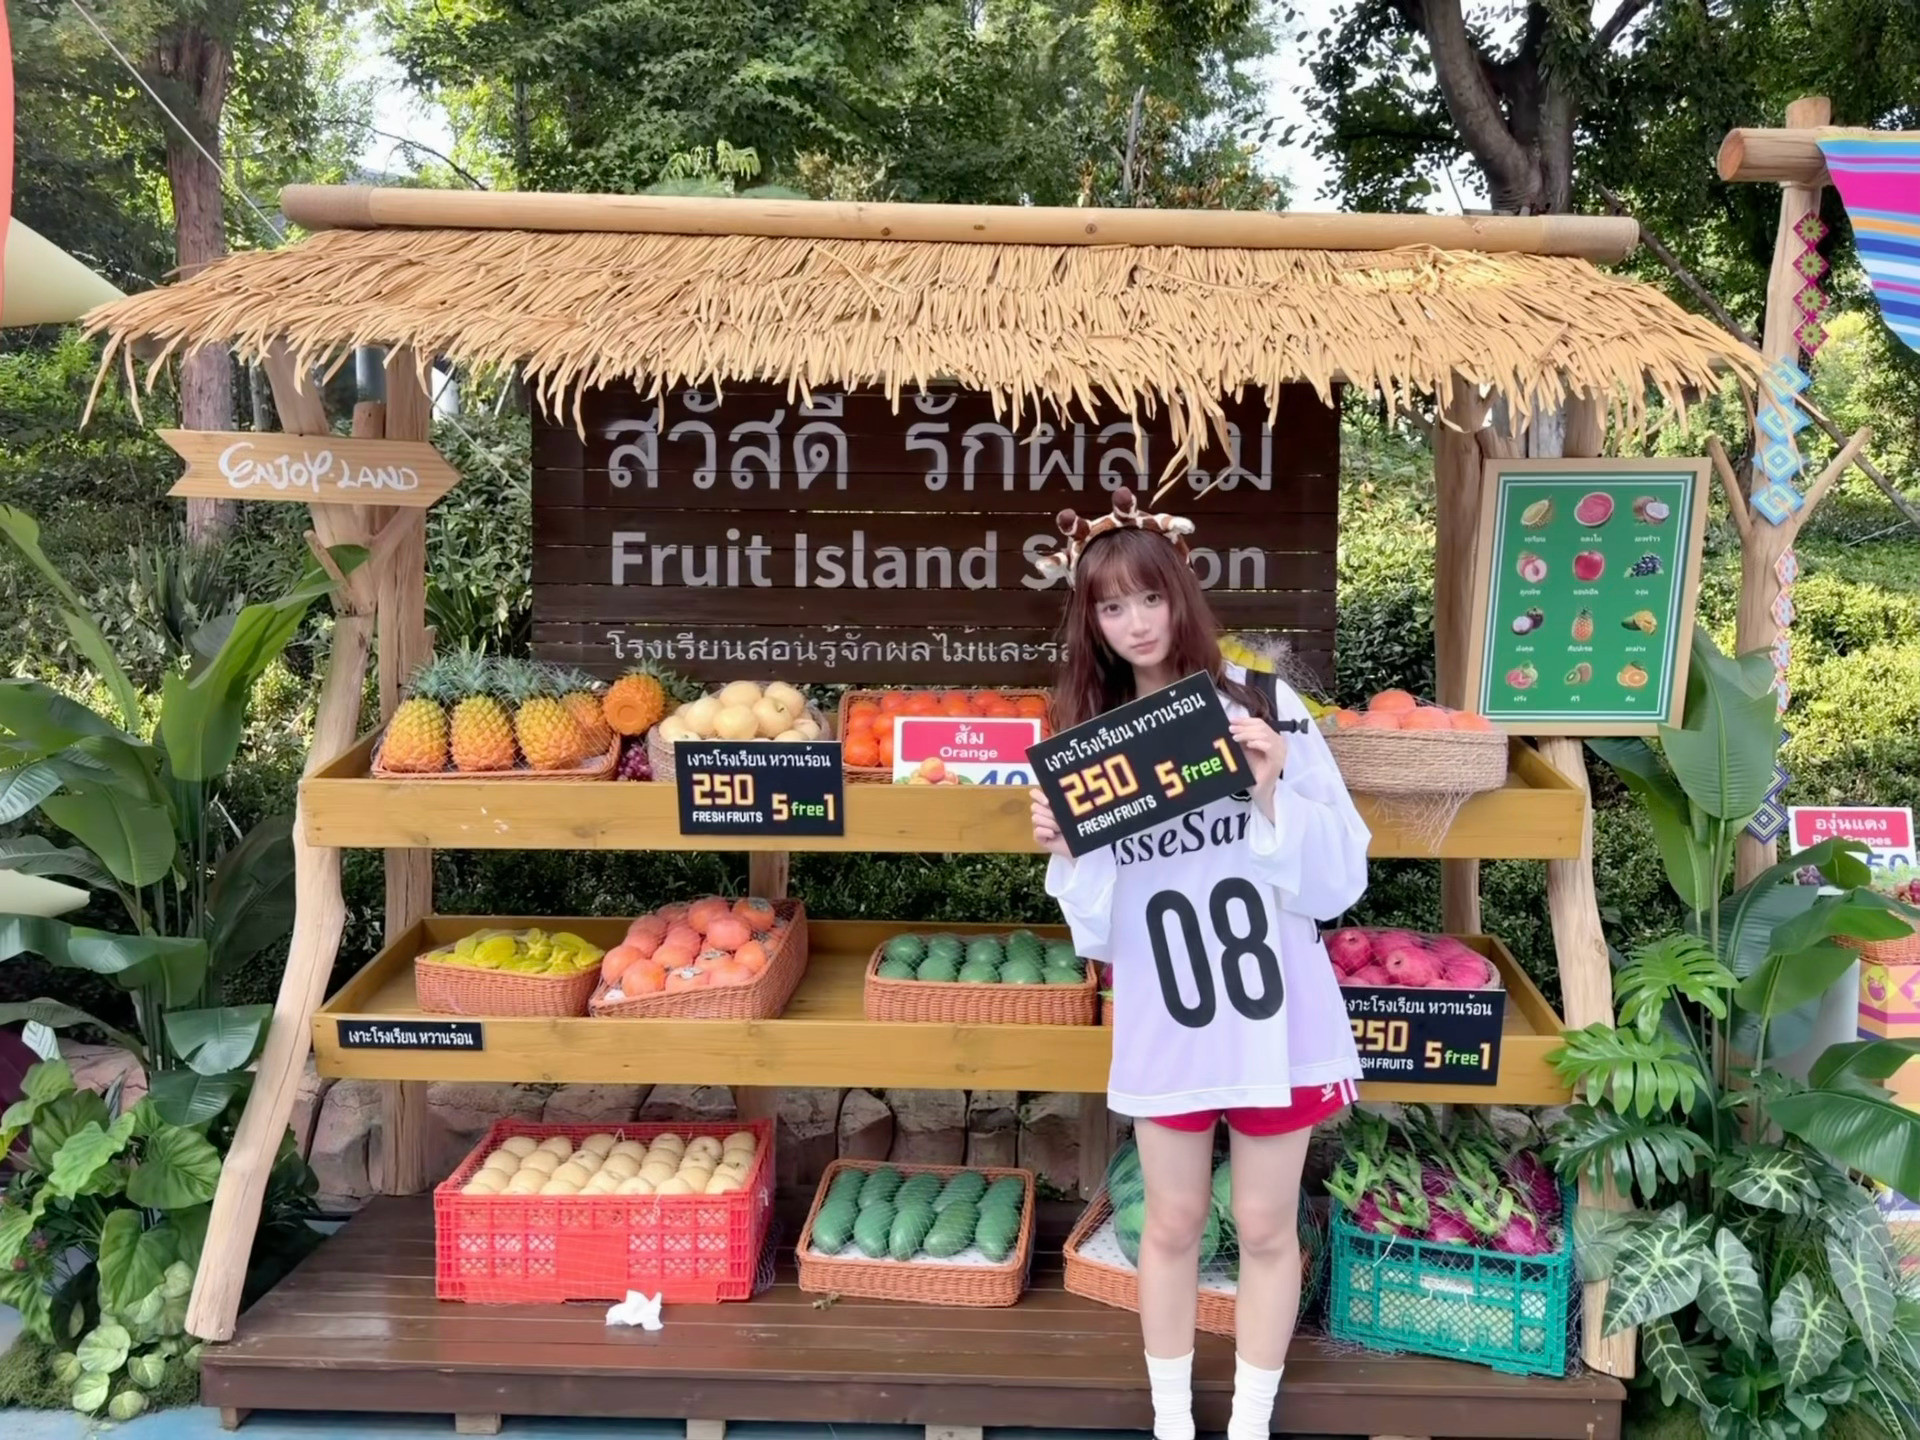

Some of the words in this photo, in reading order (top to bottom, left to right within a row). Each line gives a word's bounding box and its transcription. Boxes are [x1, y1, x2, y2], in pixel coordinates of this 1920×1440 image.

[604, 388, 848, 490] สวัสดี
[336, 458, 419, 491] LAND
[611, 527, 772, 589] Fruit
[794, 529, 999, 590] Island
[954, 723, 985, 746] ส้ม
[1044, 727, 1135, 772] เงาะโรงเรียน
[1132, 690, 1207, 734] หวานร้อน
[687, 748, 767, 768] เงาะโรงเรียน
[769, 747, 832, 769] หวานร้อน
[939, 746, 998, 760] Orange
[692, 773, 755, 806] 250
[1058, 753, 1140, 818] 250
[692, 811, 727, 823] FRESH
[727, 811, 763, 824] FRUITS
[1076, 812, 1116, 838] FRESH
[1113, 794, 1157, 823] FRUITS
[1145, 876, 1285, 1029] 08
[1345, 995, 1426, 1014] งาะโรงเรียน
[1428, 993, 1493, 1016] หวานร้อน
[348, 1026, 417, 1044] เงาะโรงเรียน
[419, 1024, 474, 1046] หวานร้อน
[1350, 1018, 1410, 1053] 250
[1375, 1057, 1414, 1071] FRUITS
